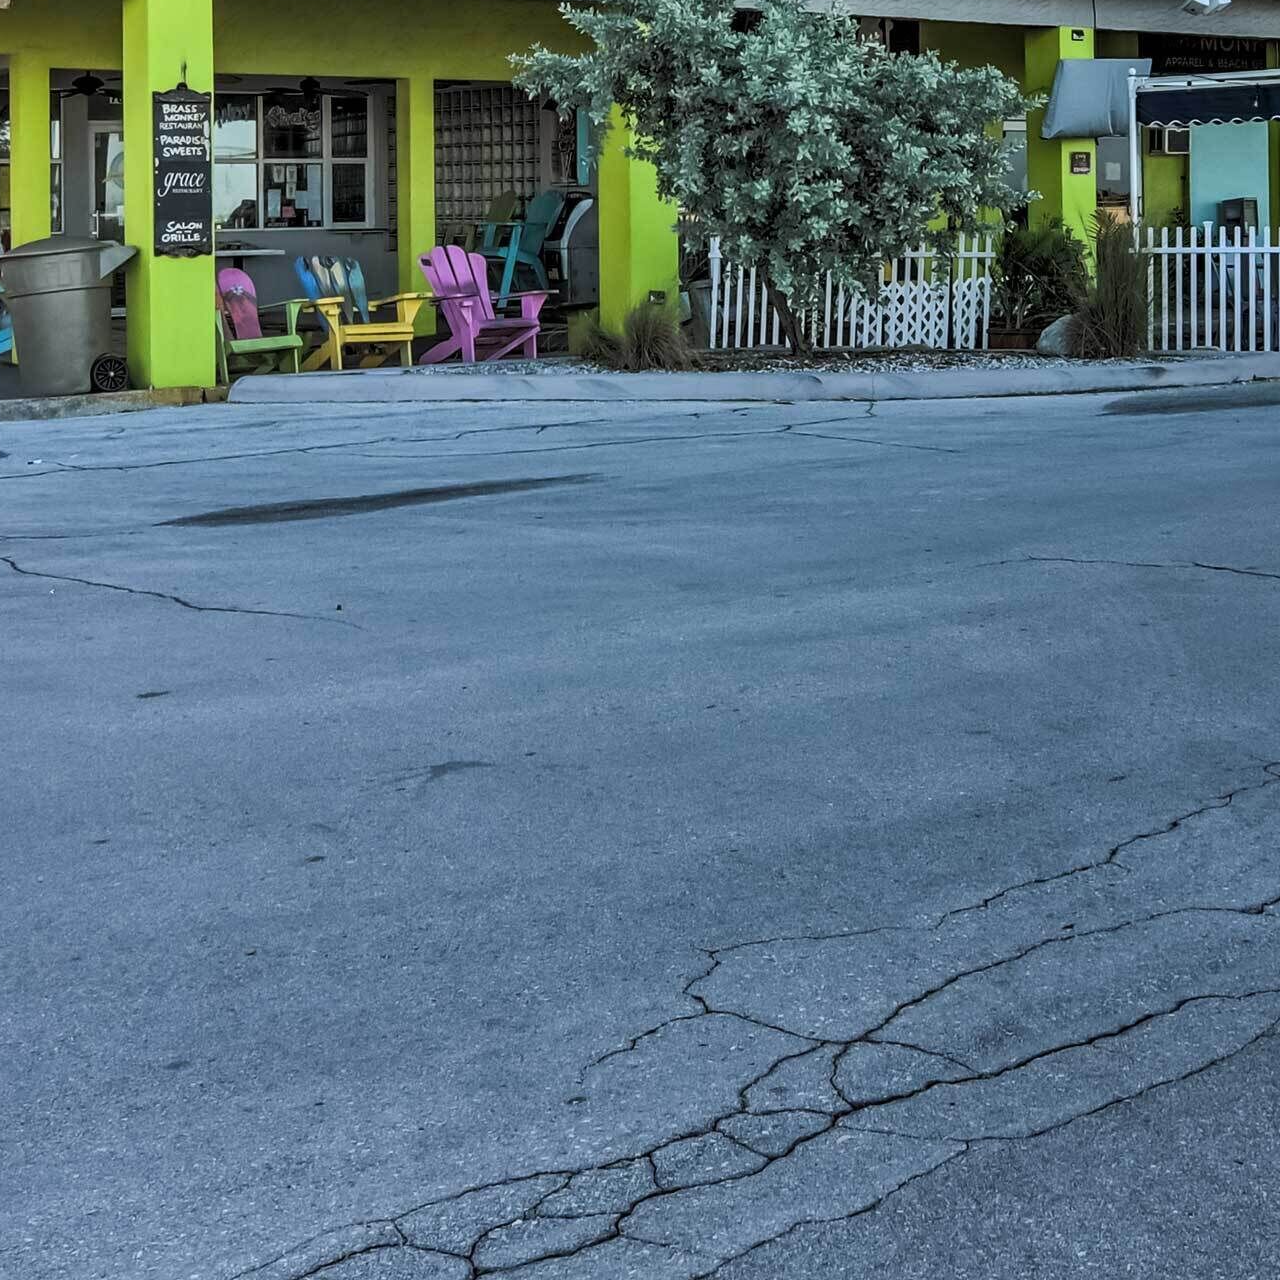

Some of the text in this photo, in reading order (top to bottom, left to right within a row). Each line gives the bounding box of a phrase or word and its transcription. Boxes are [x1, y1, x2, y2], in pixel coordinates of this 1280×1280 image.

[162, 104, 197, 115] BRASS
[164, 112, 206, 122] MONKEY
[160, 135, 206, 146] PARADISE
[162, 147, 204, 158] SWEETS
[157, 171, 206, 197] grace
[165, 221, 203, 233] SALON
[161, 233, 201, 243] GRILLE
